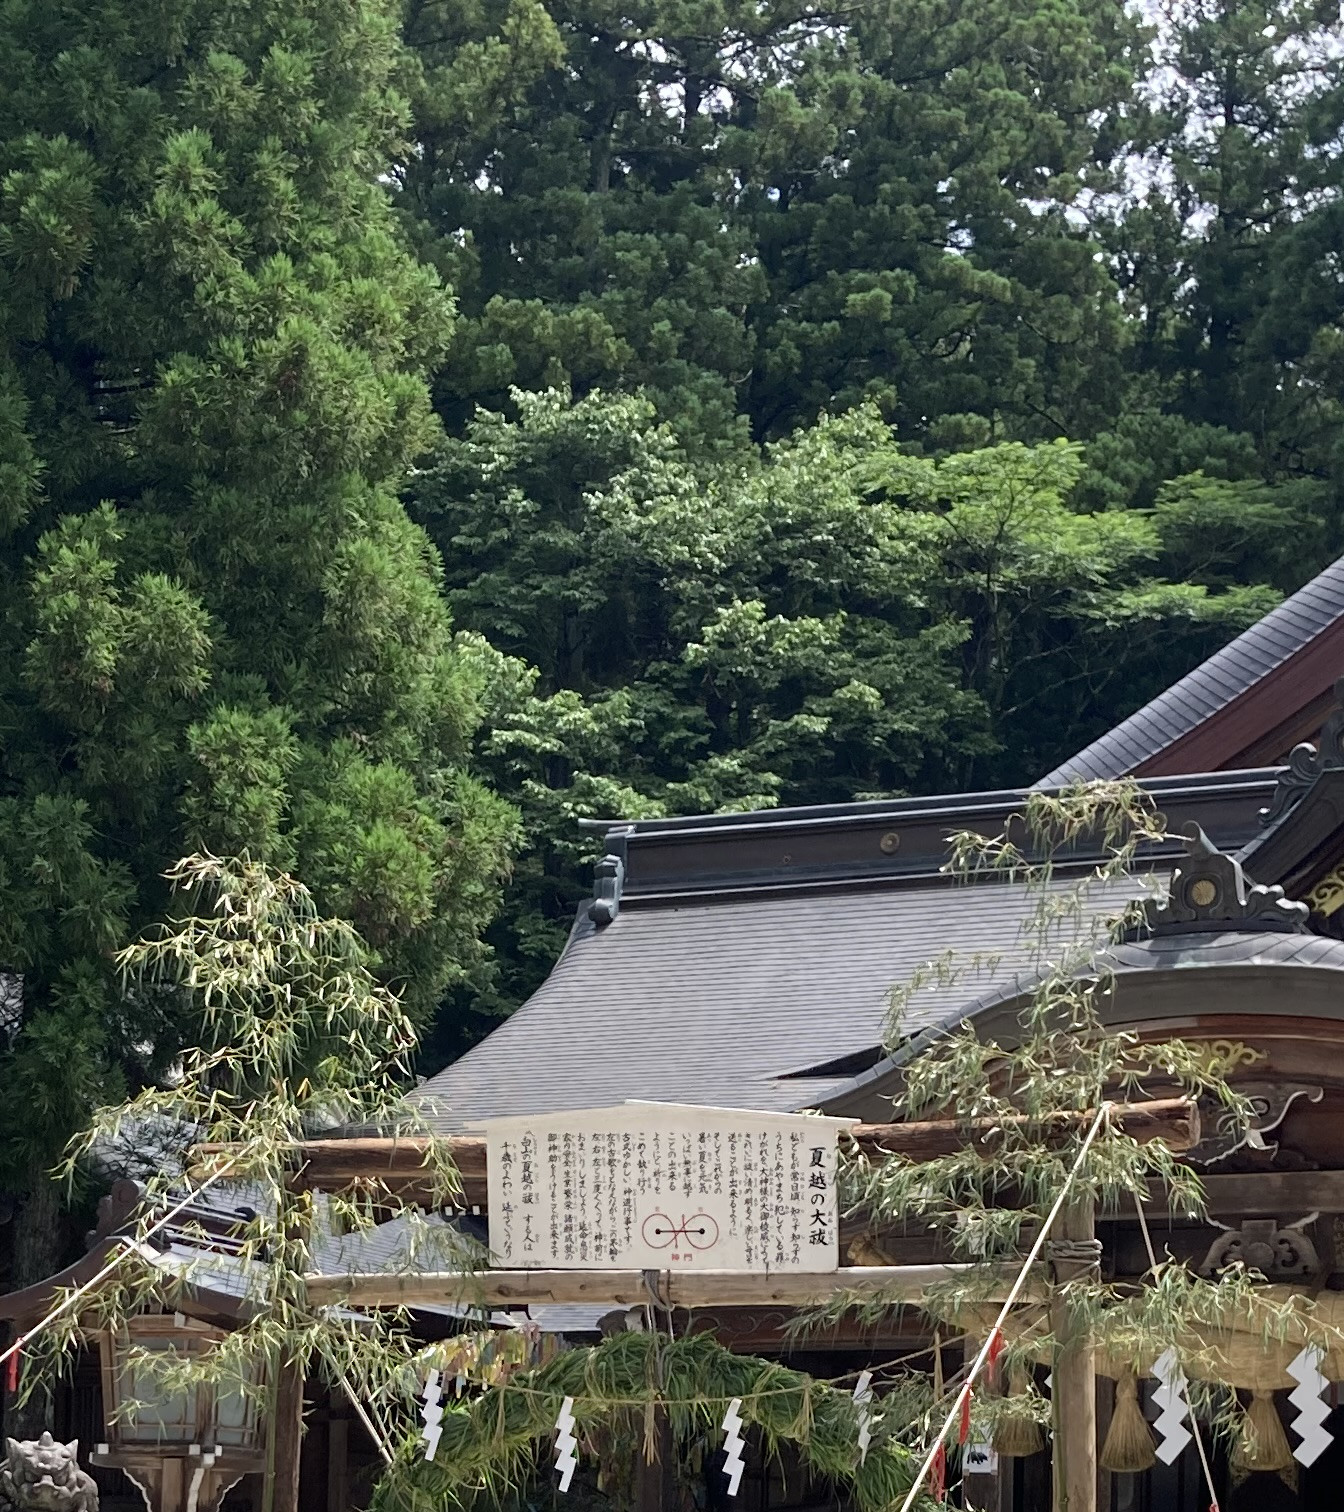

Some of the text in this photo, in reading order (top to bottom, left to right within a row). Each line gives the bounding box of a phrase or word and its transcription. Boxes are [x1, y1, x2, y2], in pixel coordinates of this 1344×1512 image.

[809, 1146, 828, 1246] 夏越の大祓
